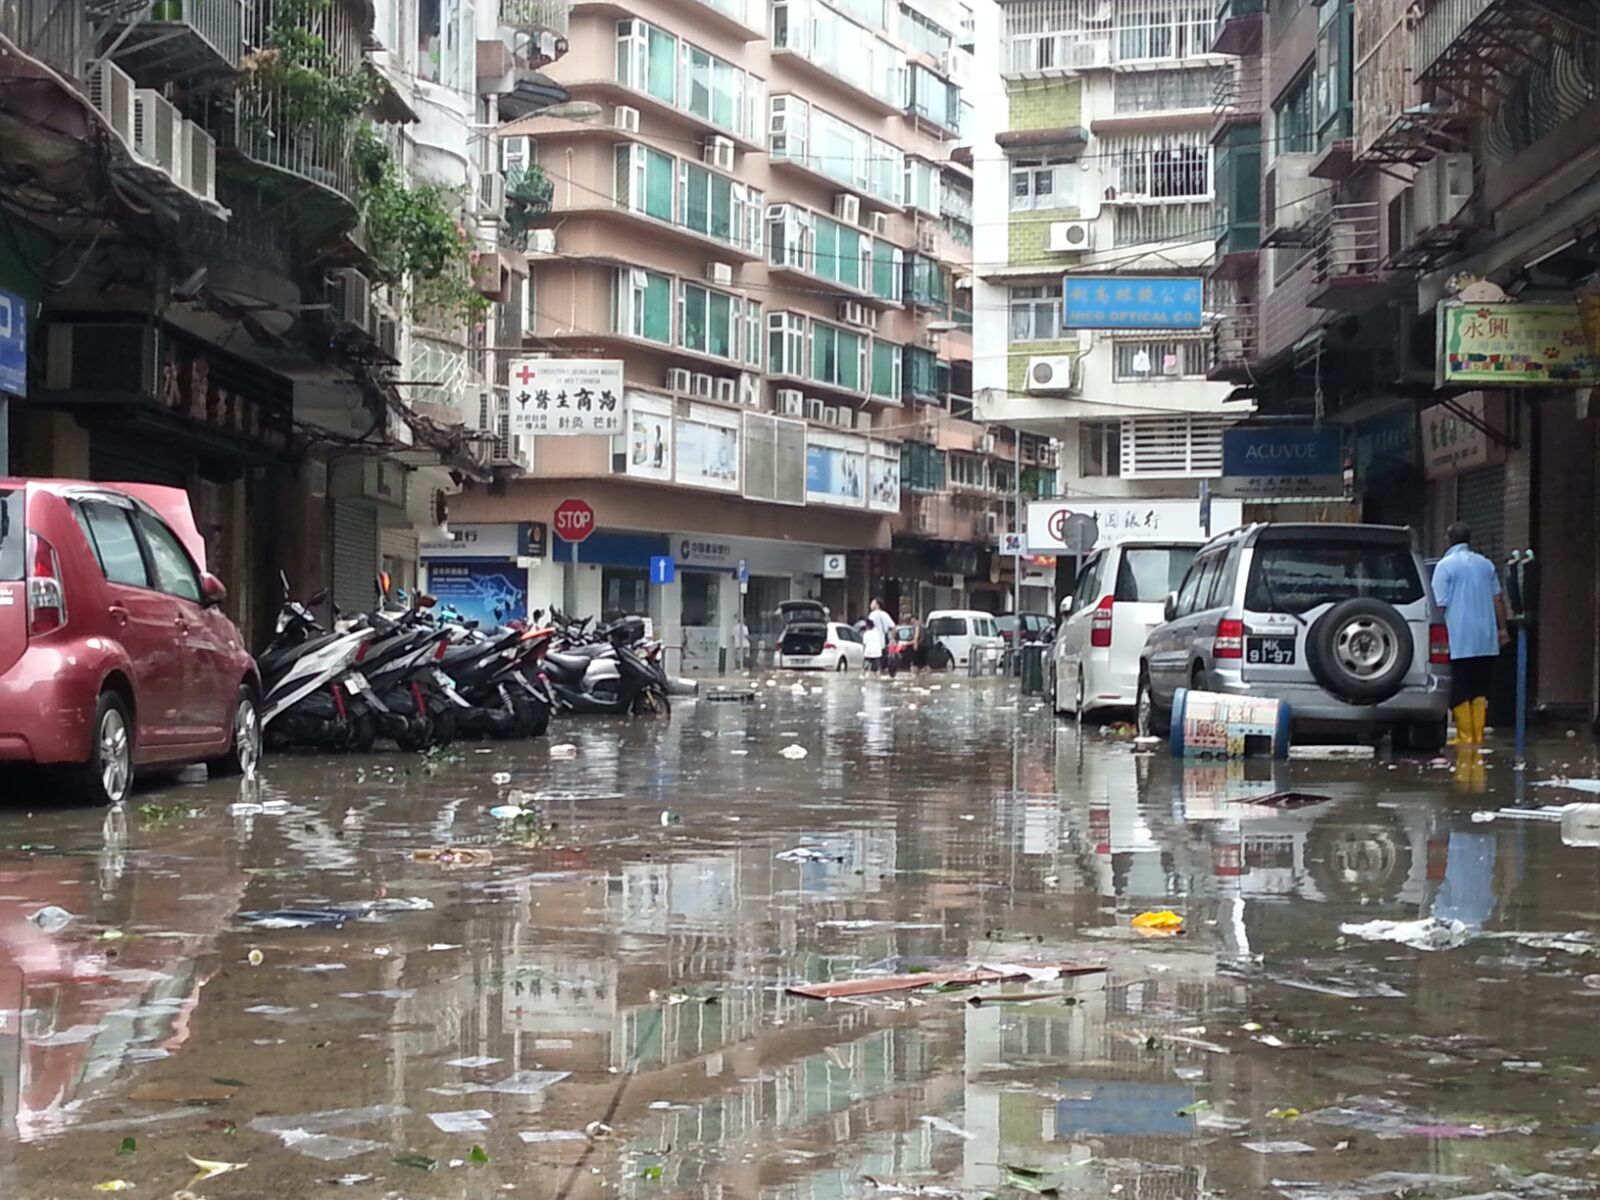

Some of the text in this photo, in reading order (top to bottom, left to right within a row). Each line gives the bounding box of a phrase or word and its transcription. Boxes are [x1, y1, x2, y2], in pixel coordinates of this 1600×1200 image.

[1110, 311, 1168, 323] OPTICAL
[1463, 316, 1510, 339] 永興
[1245, 442, 1319, 459] ACUVUE
[557, 511, 591, 528] STOP
[1262, 639, 1280, 651] MK
[1249, 649, 1292, 662] 91-97
